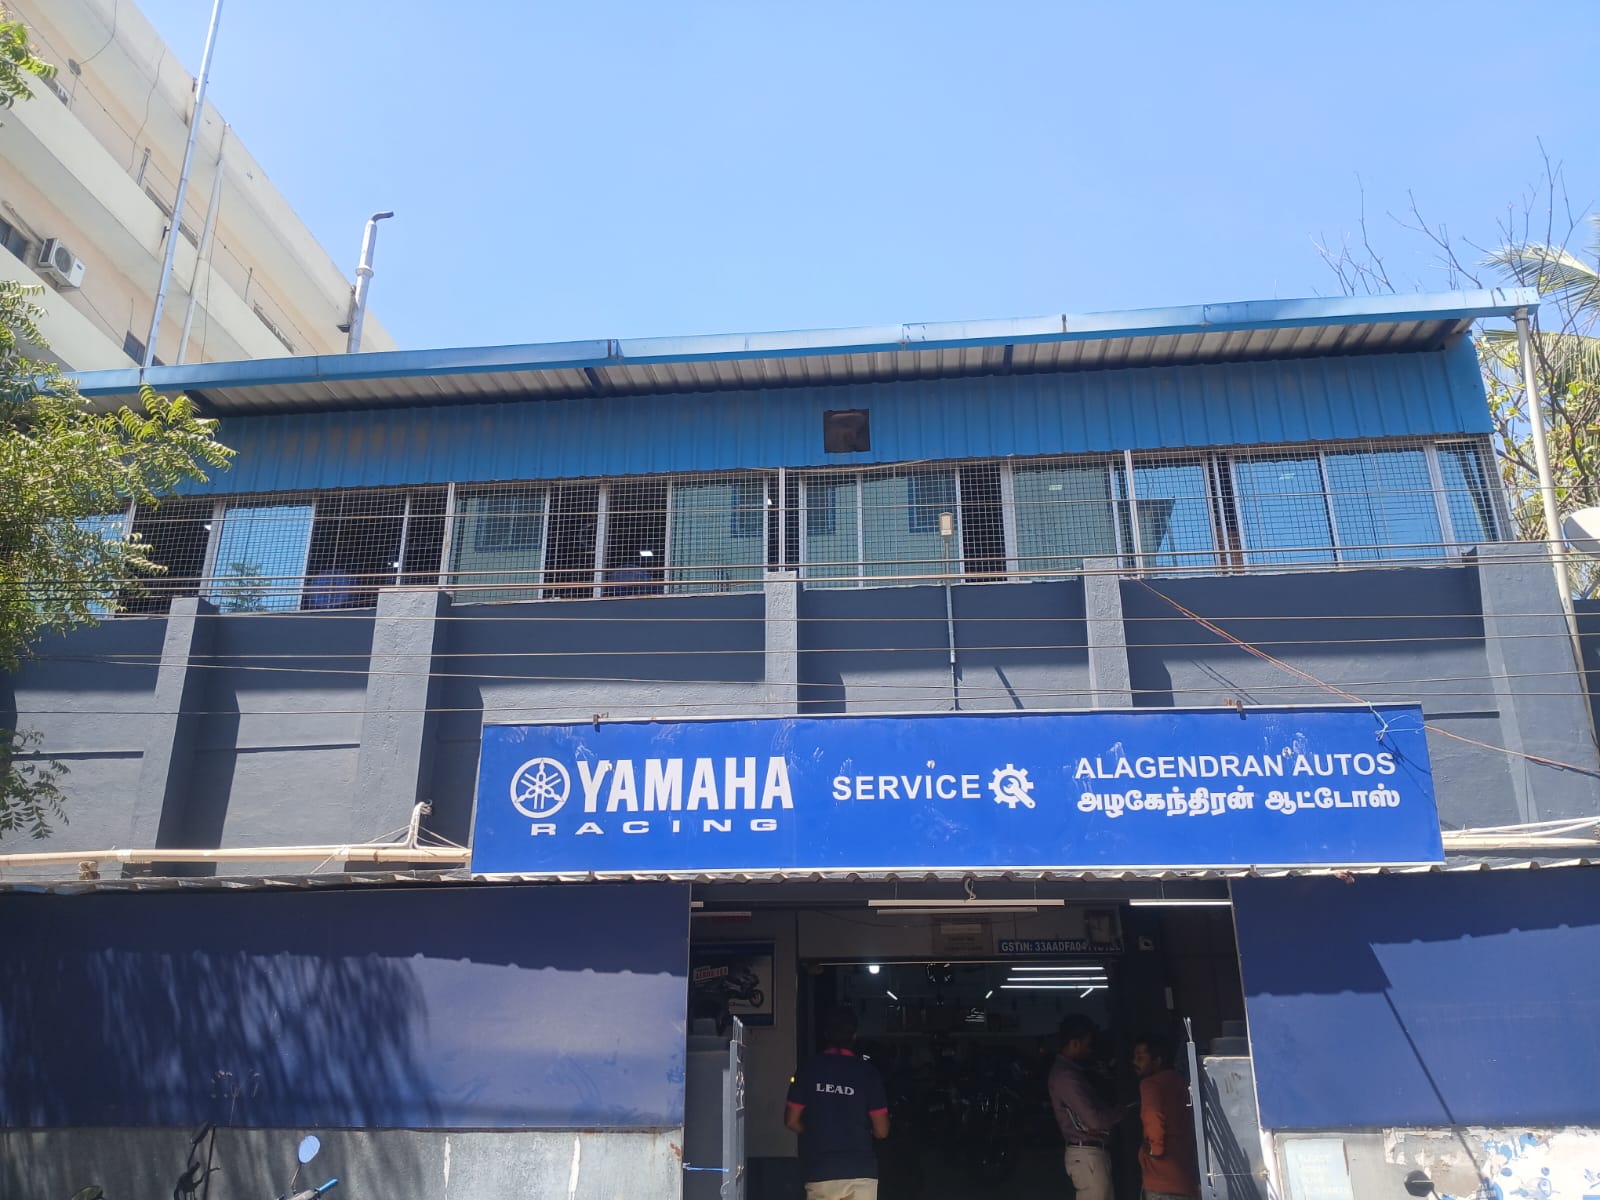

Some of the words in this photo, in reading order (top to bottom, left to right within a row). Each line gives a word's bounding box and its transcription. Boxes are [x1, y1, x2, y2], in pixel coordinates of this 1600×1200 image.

[1074, 755, 1284, 780] ALAGENDRAN
[1292, 752, 1396, 777] AUTOS
[576, 756, 794, 813] YAMAHA
[832, 774, 981, 801] SERVICE
[1076, 785, 1256, 819] அழகேந்திரன்
[1264, 782, 1401, 815] ஆட்டோஸ்
[530, 818, 778, 836] RACING
[1001, 941, 1033, 953] GSTIN:
[815, 1082, 855, 1096] LEAD
